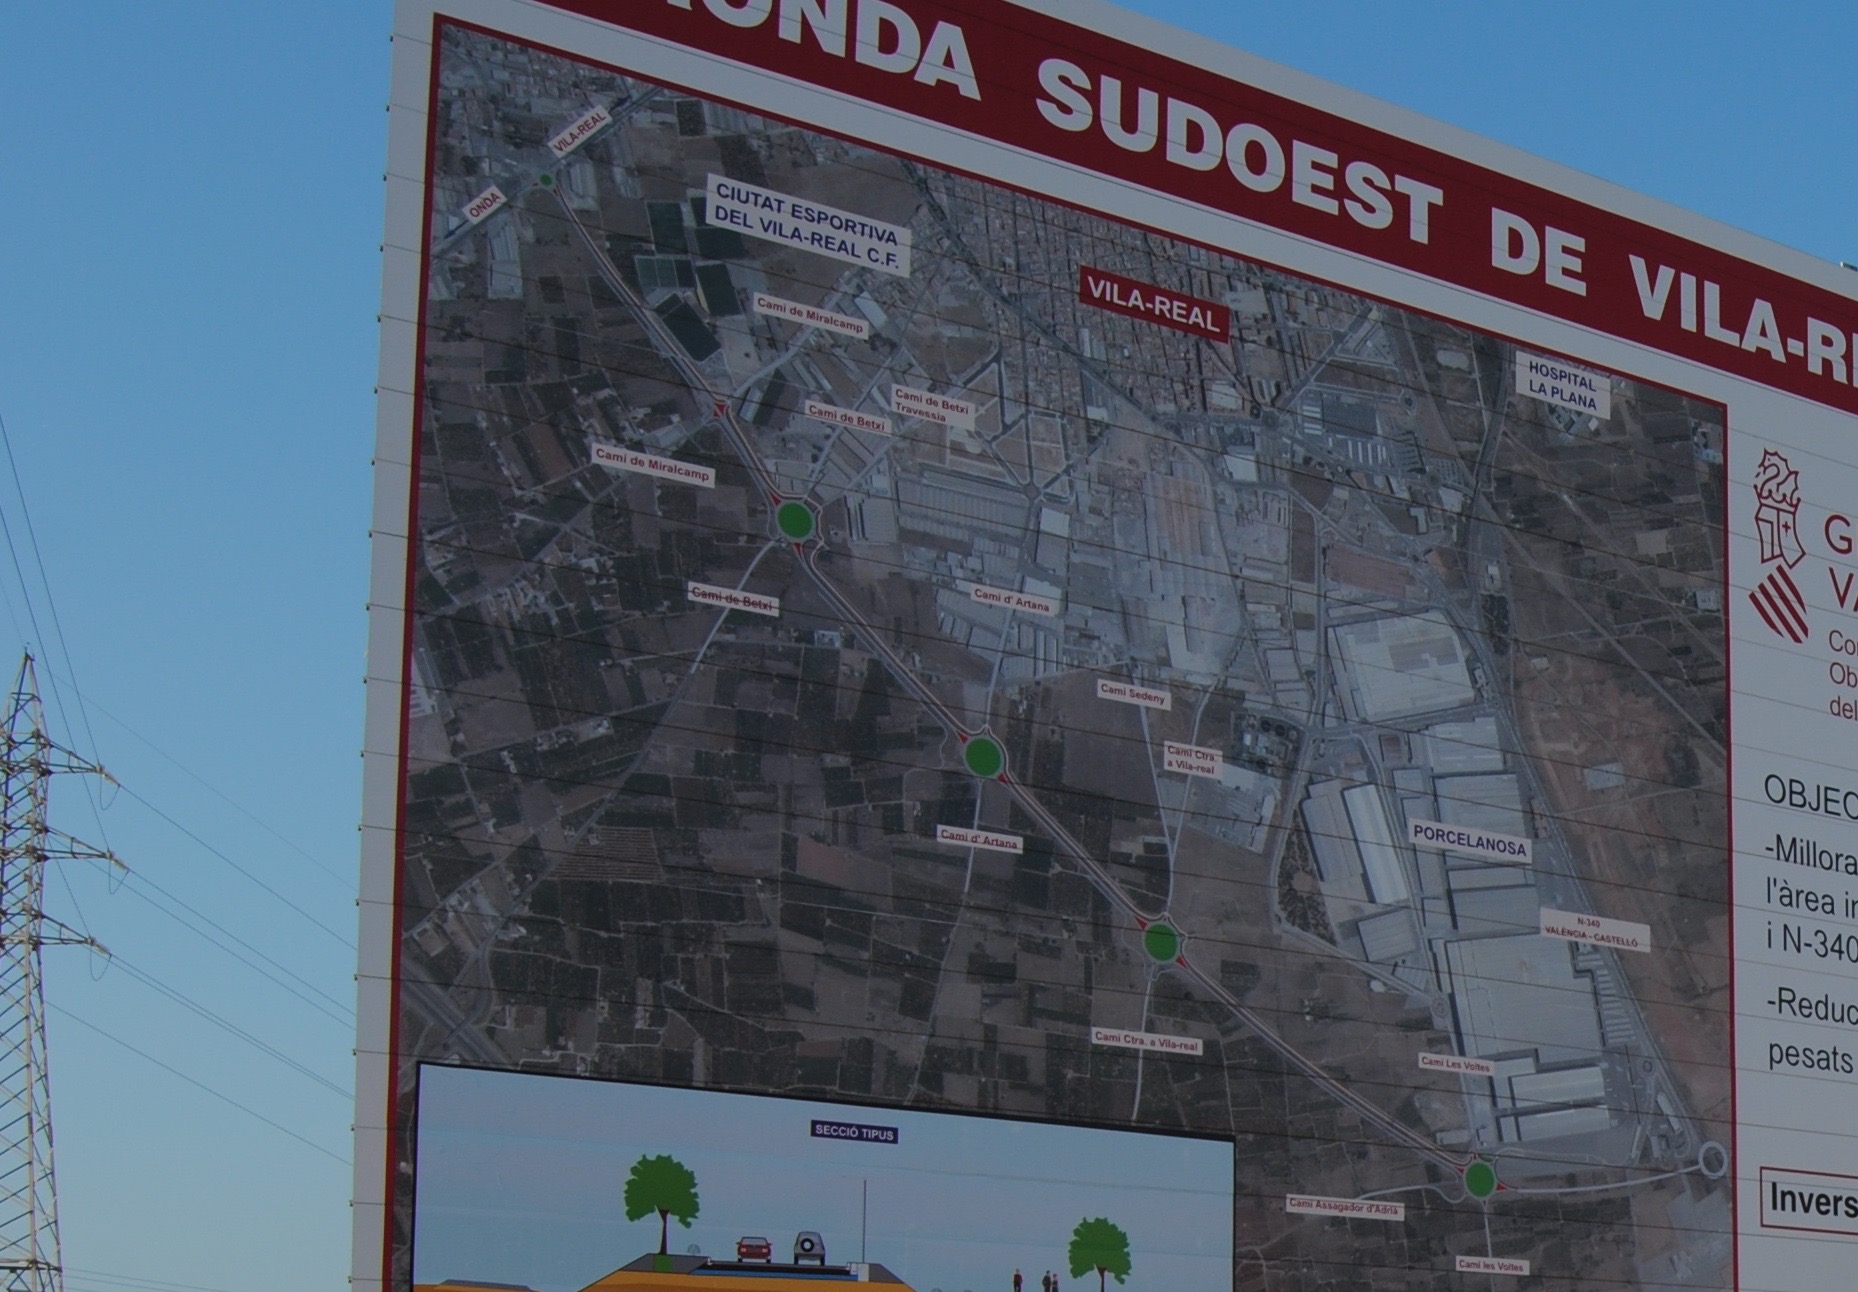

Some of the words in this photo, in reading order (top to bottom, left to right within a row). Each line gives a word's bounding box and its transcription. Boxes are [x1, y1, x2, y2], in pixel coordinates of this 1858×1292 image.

[553, 111, 607, 152] VILA-REAL
[667, 0, 981, 101] ONDA
[1036, 58, 1443, 244] SUDOEST
[1491, 206, 1587, 297] DE
[469, 192, 500, 218] ONDA
[716, 182, 786, 214] CIUTAT
[791, 203, 898, 246] ESPORTIVA
[715, 205, 754, 229] DEL
[759, 217, 861, 259] VILA-REAL
[867, 246, 899, 269] C.F.
[1087, 275, 1221, 333] VILA-REAL
[789, 305, 803, 317] de
[806, 309, 864, 334] Miralcamp
[1528, 360, 1597, 393] HOSPITAL
[925, 396, 939, 408] de
[1528, 378, 1548, 398] LA
[1550, 382, 1597, 412] PLANA
[840, 412, 854, 424] de
[630, 455, 645, 467] de
[648, 459, 709, 483] Miralcamp
[725, 593, 739, 606] de
[1016, 597, 1050, 612] Artana
[1129, 688, 1165, 705] Sedeny
[1829, 694, 1858, 722] del
[1175, 760, 1215, 774] Vila-real
[983, 836, 1018, 849] Artana
[1413, 824, 1527, 857] PORCELANOSA
[1765, 833, 1858, 876] -Millora
[1766, 876, 1836, 915] l'àrea
[1766, 922, 1772, 950] i
[1150, 1039, 1156, 1047] a
[1158, 1038, 1198, 1051] Vila-real
[1769, 1040, 1854, 1076] pesats
[1446, 1060, 1461, 1069] Les
[815, 1124, 859, 1138] SECCIÓ
[861, 1128, 894, 1141] TIPUS
[1315, 1199, 1364, 1213] Assagador
